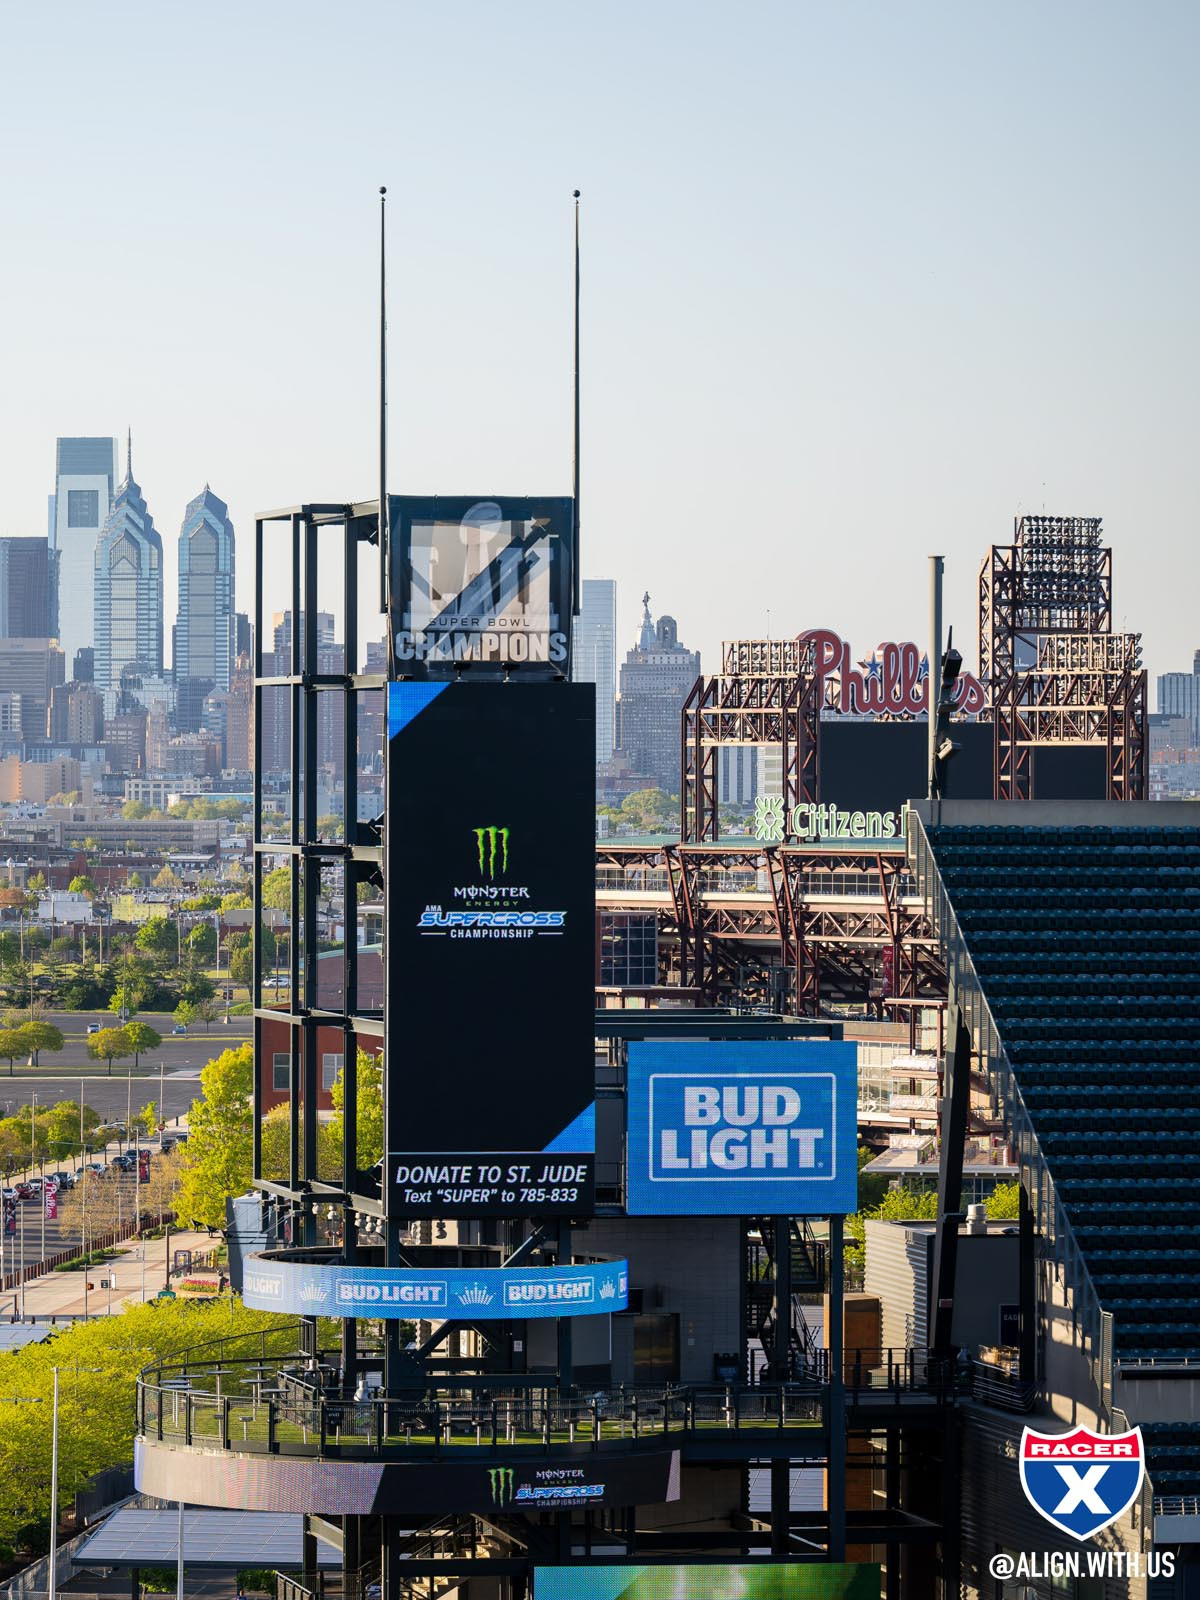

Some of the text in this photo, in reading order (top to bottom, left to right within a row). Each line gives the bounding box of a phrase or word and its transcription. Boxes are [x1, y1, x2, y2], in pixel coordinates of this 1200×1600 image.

[428, 617, 530, 627] SUPER BOWL
[395, 631, 567, 662] CHAMPIONS
[795, 628, 985, 715] Phillis
[792, 803, 897, 838] Citizens
[453, 885, 530, 900] MONSTER
[416, 911, 567, 927] SUPERCROSS
[450, 929, 534, 939] CHAMPIONSHIP
[684, 1086, 801, 1126] BUD
[661, 1128, 824, 1170] LIGHT
[396, 1165, 588, 1184] DONATE TO ST. JUDE
[404, 1188, 432, 1203] Text
[501, 1189, 515, 1202] to
[519, 1188, 578, 1202] 785-833
[339, 1284, 443, 1301] BUD LIGHT
[508, 1281, 591, 1301] BUD LIGHT
[536, 1469, 585, 1479] MONSTER
[536, 1498, 587, 1507] CHAMPIONSHIP
